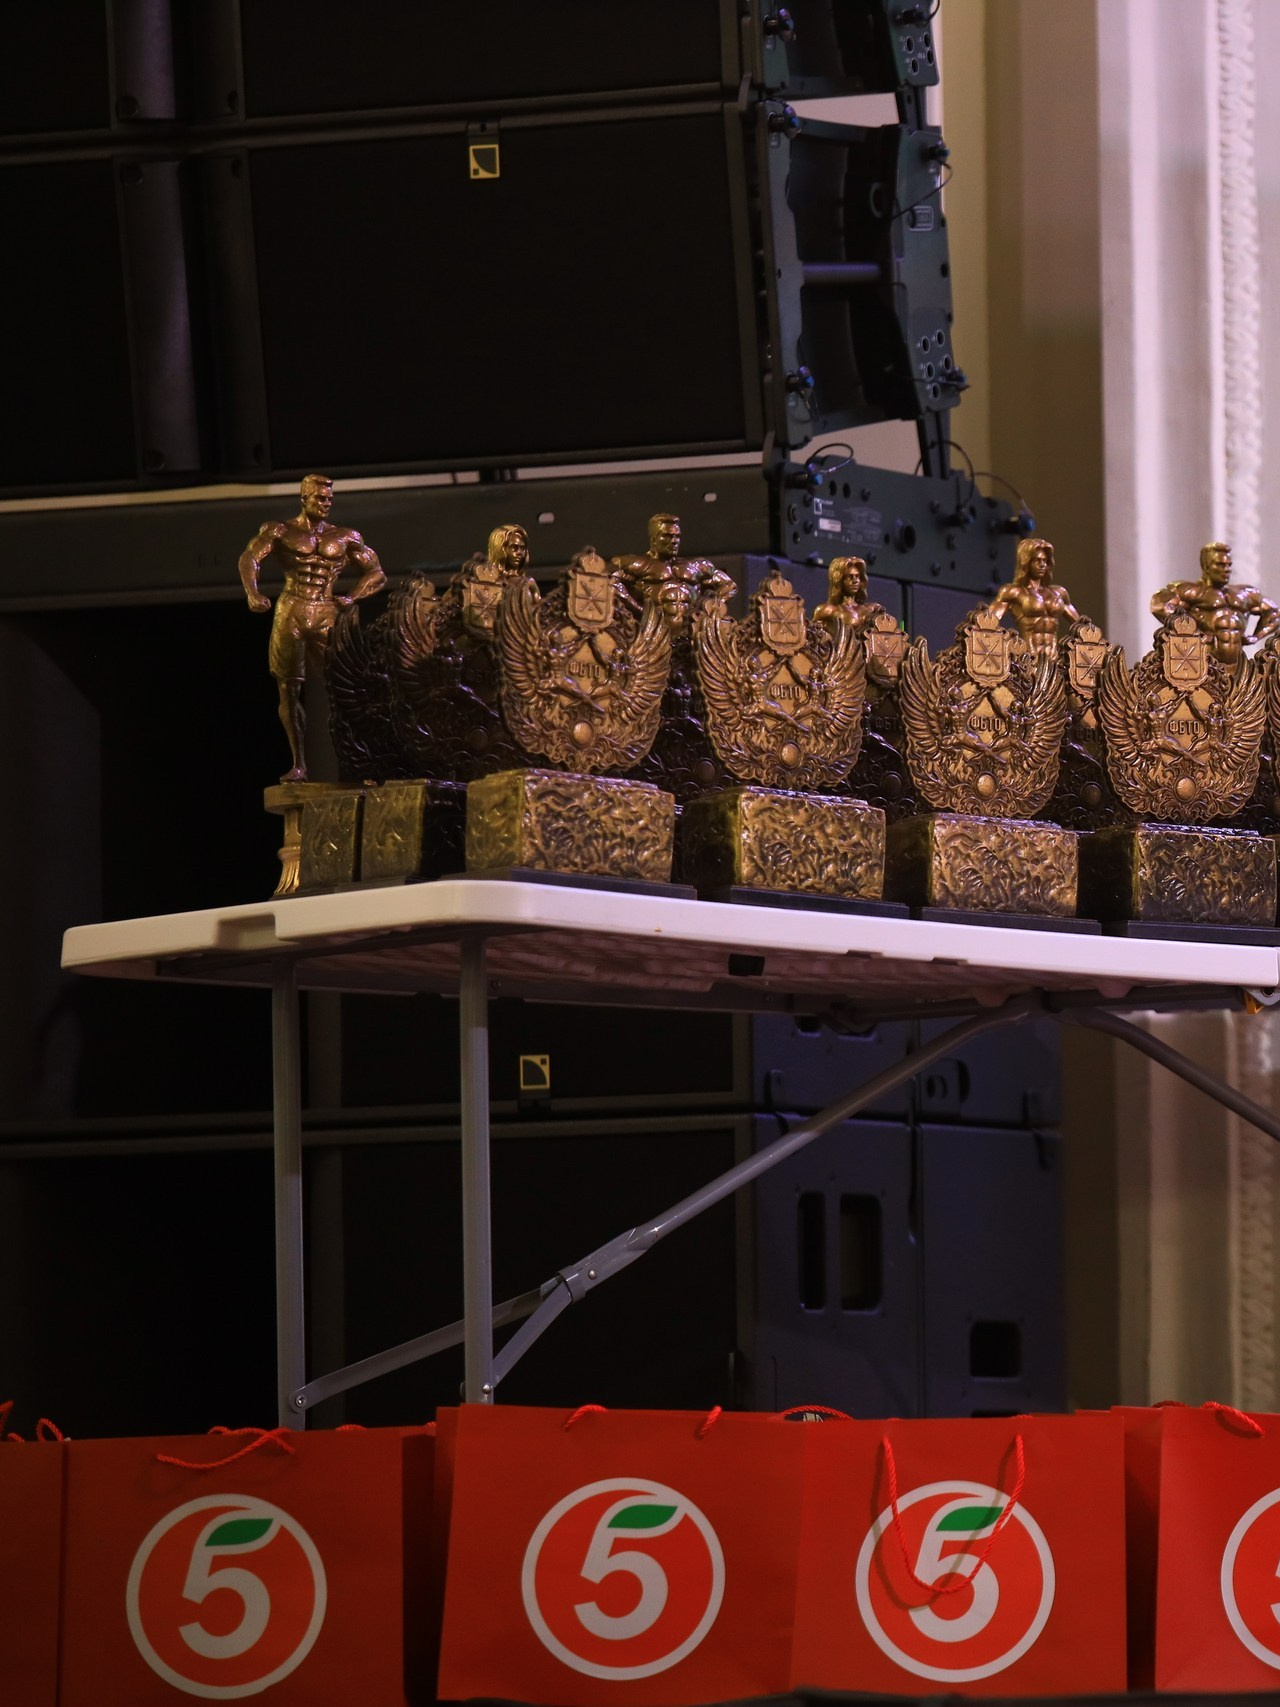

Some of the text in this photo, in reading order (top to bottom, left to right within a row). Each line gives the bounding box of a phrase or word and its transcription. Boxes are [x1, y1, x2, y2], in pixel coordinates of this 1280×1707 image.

[970, 715, 1001, 731] ФБТО
[1169, 719, 1200, 735] ФБТО
[179, 1507, 283, 1660] 5
[573, 1493, 687, 1640] 5
[908, 1494, 1009, 1642] 5
